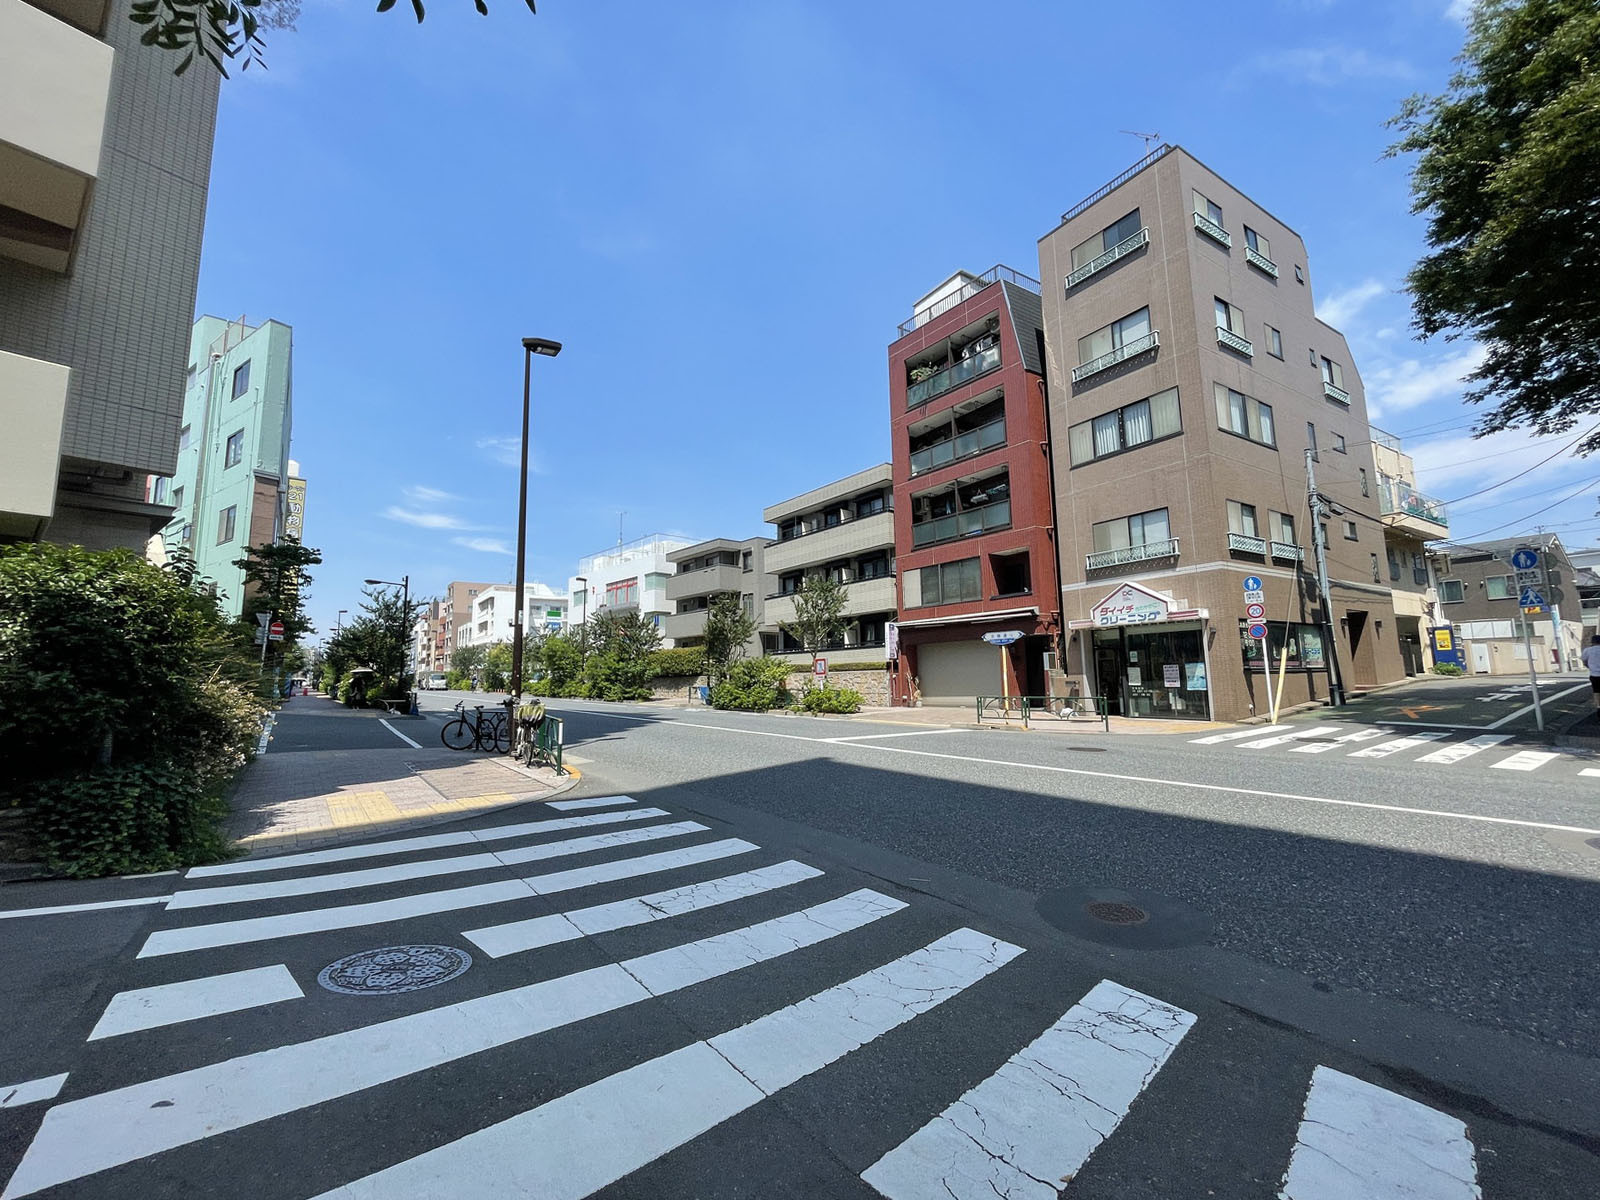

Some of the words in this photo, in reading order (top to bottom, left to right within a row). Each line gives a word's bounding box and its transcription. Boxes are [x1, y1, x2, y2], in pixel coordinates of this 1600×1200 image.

[1100, 604, 1134, 616] ダイイチ
[1250, 607, 1261, 615] 20
[1100, 611, 1161, 625] クリーニング
